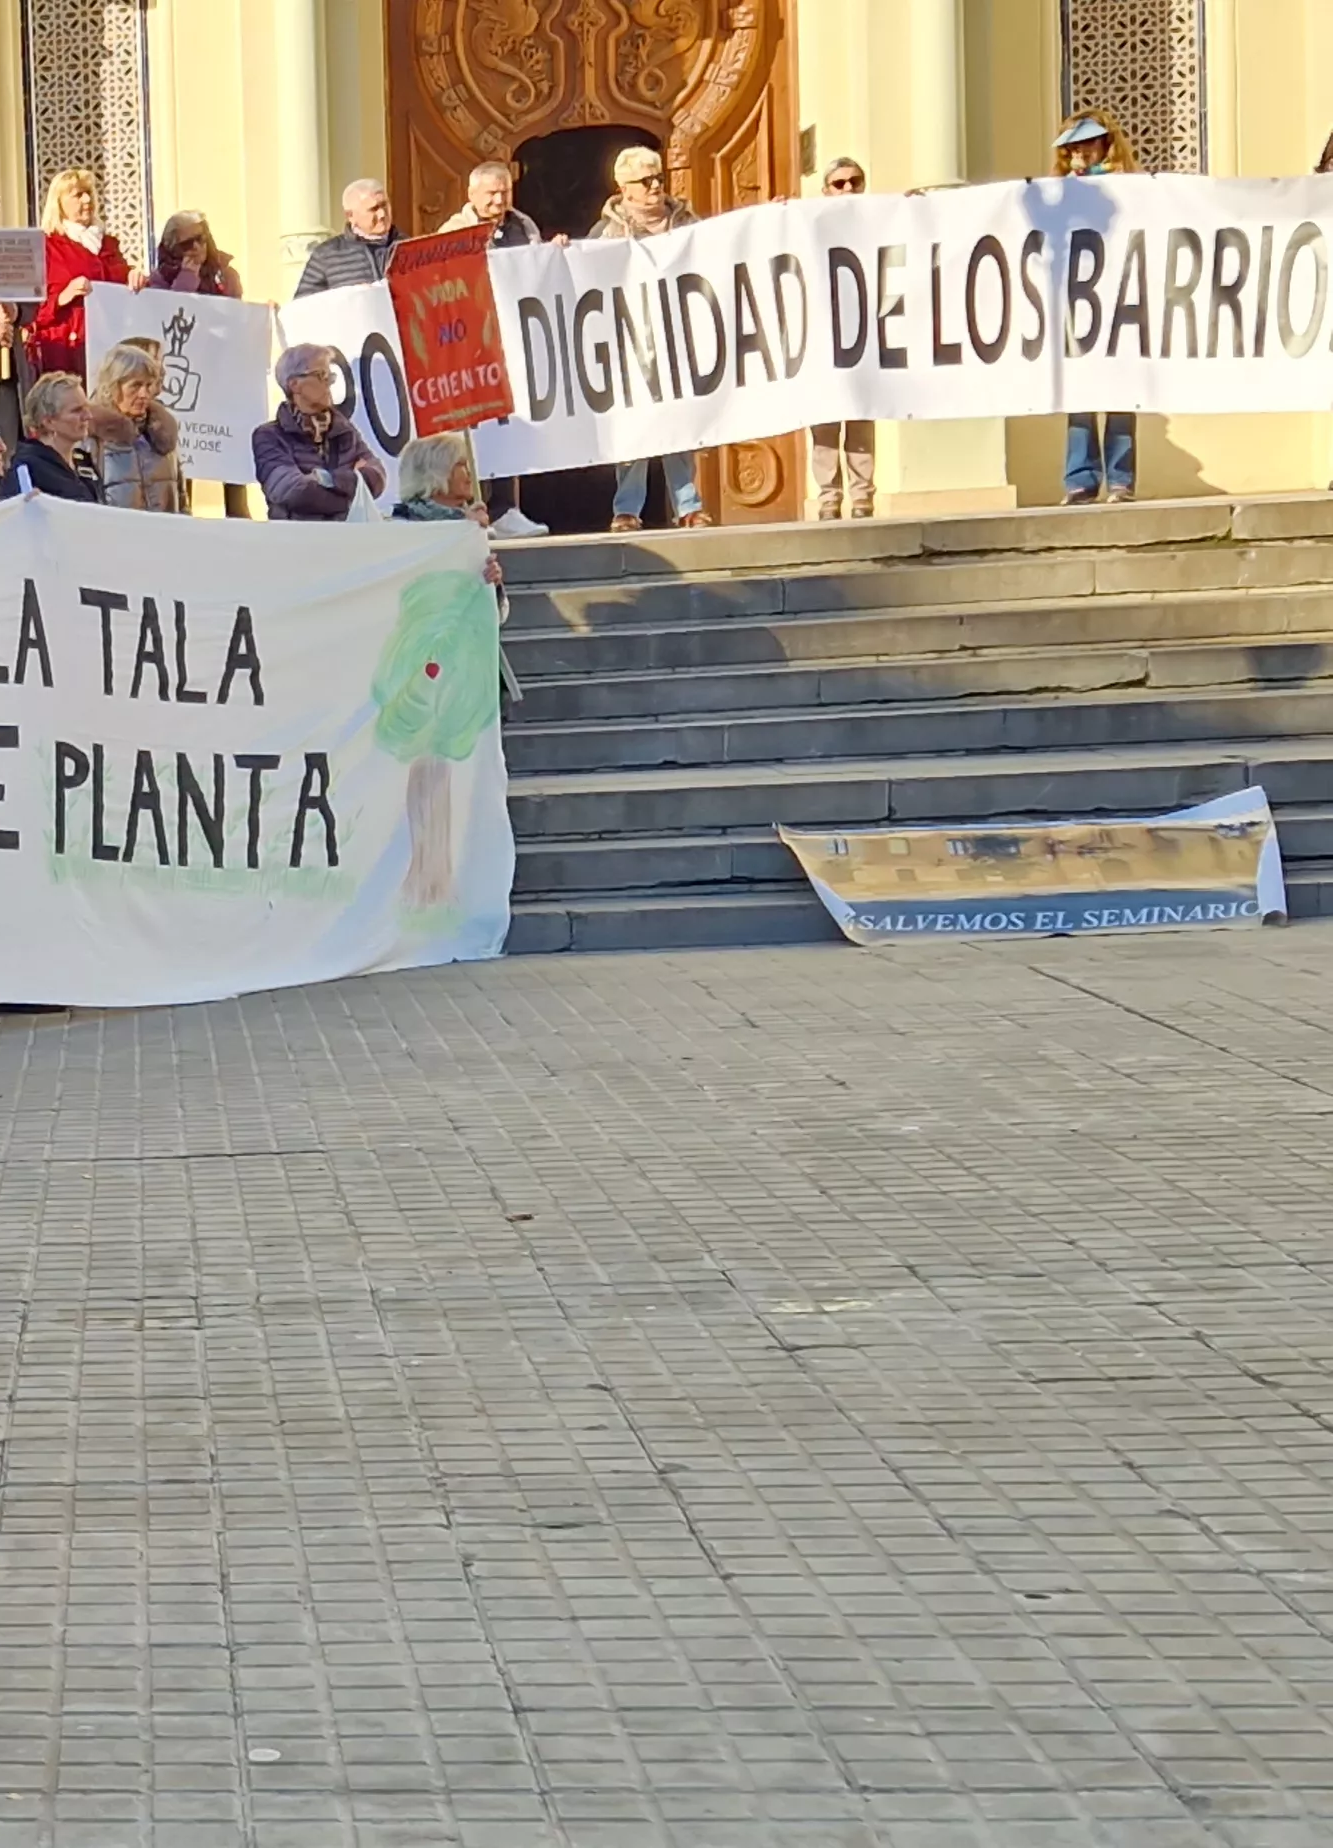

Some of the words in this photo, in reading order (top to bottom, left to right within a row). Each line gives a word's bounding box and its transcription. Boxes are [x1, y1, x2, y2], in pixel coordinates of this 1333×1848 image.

[438, 318, 468, 348] NO
[517, 253, 808, 423] DIGNIDAD
[828, 243, 909, 370] DE
[931, 229, 1046, 367] LOS
[1064, 221, 1333, 359] BARRIO
[412, 362, 502, 409] CEMENTO
[185, 421, 233, 437] VECINAL
[79, 587, 266, 707] TALA
[53, 741, 339, 869] PLANTA
[1034, 910, 1074, 930] EL
